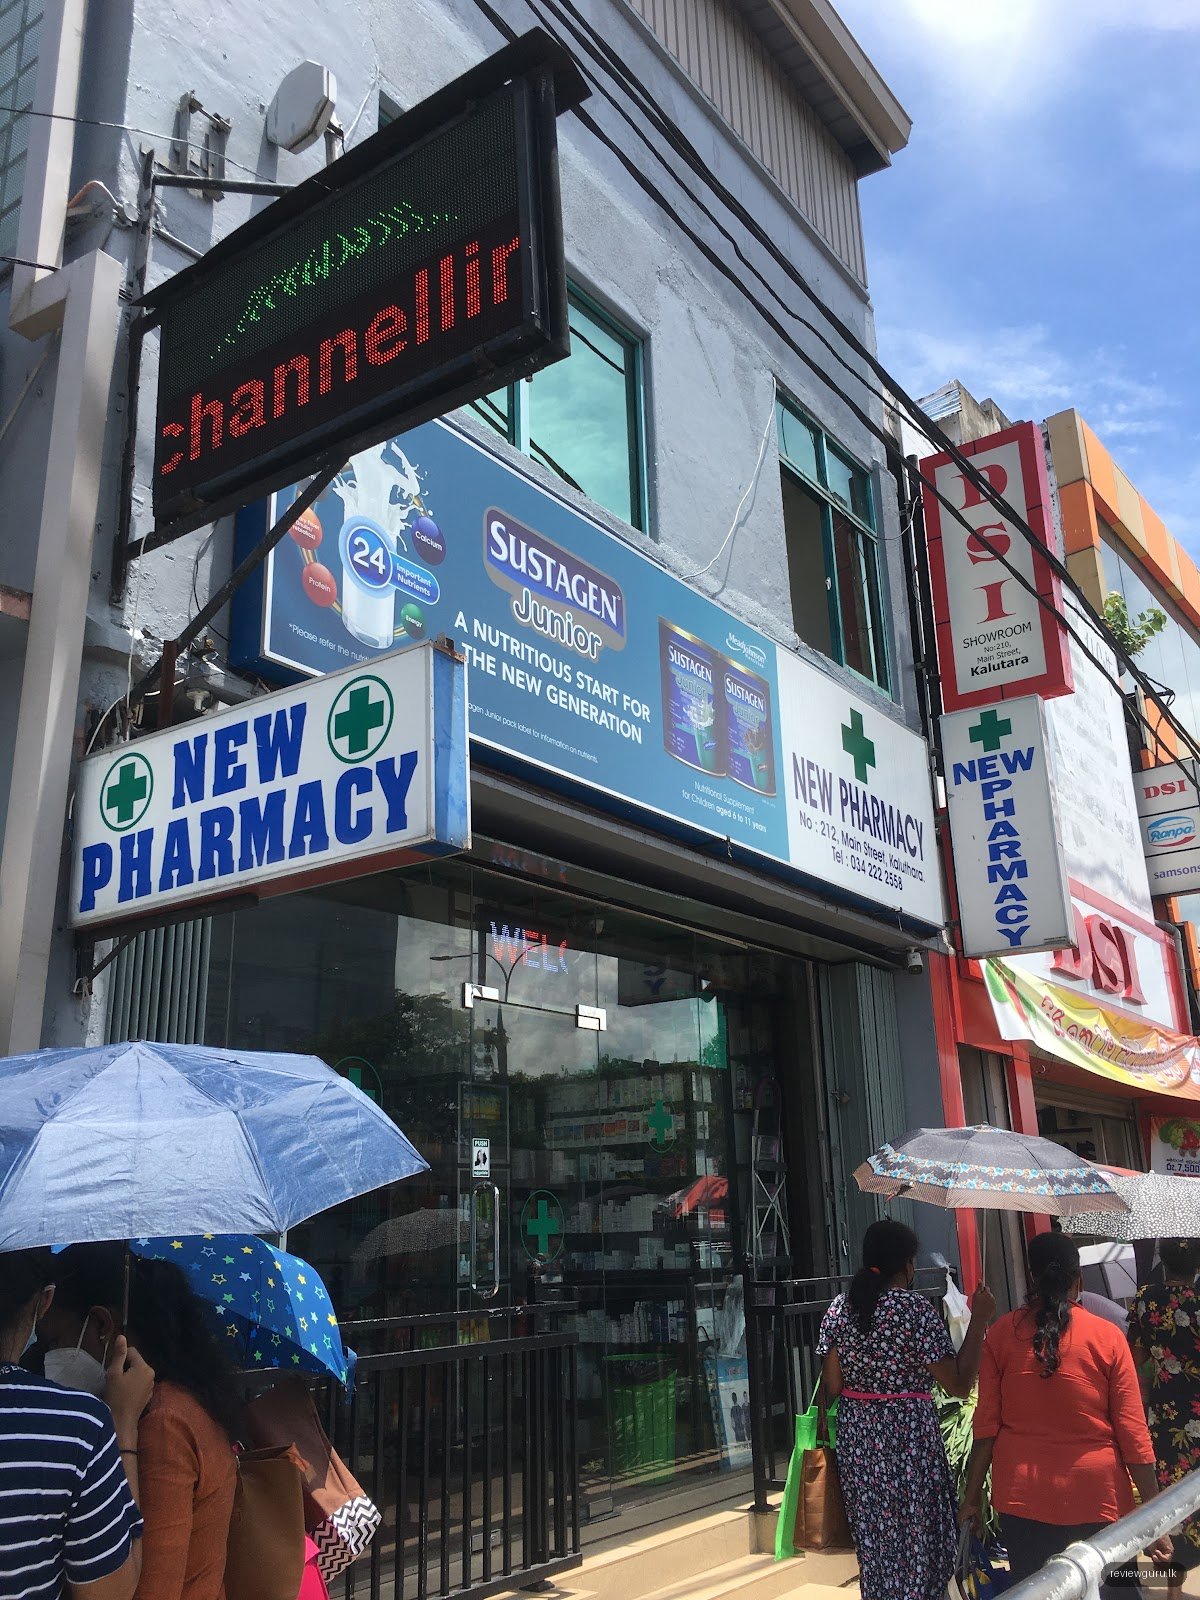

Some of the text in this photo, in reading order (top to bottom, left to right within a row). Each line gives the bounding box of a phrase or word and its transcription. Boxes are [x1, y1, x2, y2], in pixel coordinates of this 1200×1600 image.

[353, 536, 385, 575] 24
[415, 531, 443, 552] Calcium
[951, 463, 1017, 625] DSI
[308, 576, 331, 593] Protein
[396, 562, 432, 587] Important
[397, 573, 431, 597] Nutrients
[405, 614, 423, 628] Energy
[513, 587, 602, 660] Junior
[962, 621, 1032, 650] SHOWROOM
[318, 636, 336, 650] refer
[337, 643, 349, 656] the
[668, 644, 712, 684] SUSTAGEN
[976, 647, 1022, 664] Main Street,
[983, 641, 1012, 654] No:210,
[454, 610, 469, 633] A
[473, 618, 572, 684] NUTRITIOUS
[576, 671, 619, 706] START
[623, 693, 651, 723] FOR
[970, 655, 1030, 677] Kalutara
[462, 642, 497, 677] THE
[502, 661, 542, 697] NEW
[546, 684, 642, 745] GENERATION
[726, 677, 764, 712] SUSTAGEN
[484, 708, 502, 722] Junior
[502, 716, 517, 731] pack
[517, 721, 532, 736] label
[540, 731, 570, 751] information
[172, 702, 308, 810] NEW
[952, 746, 1035, 786] NEW
[694, 780, 722, 802] Nutritional
[722, 793, 755, 815] Supplement
[792, 751, 925, 862] NEW PHARMACY
[1142, 778, 1189, 800] DSI
[682, 789, 691, 801] for
[691, 793, 716, 811] Children
[715, 805, 732, 818] aged
[737, 813, 744, 823] to
[751, 821, 767, 833] years
[79, 750, 419, 913] PHARMACY
[799, 810, 812, 830] No
[820, 820, 840, 844] 212,
[841, 830, 862, 852] Main
[863, 841, 888, 867] Street,
[889, 853, 926, 883] Kaluthara.
[1150, 825, 1193, 843] Ranpa
[831, 846, 844, 864] Tel
[850, 854, 867, 876] 034
[867, 863, 883, 882] 222
[884, 871, 904, 891] 2558
[981, 778, 1031, 946] PHARMACY
[1153, 863, 1200, 880] samsons
